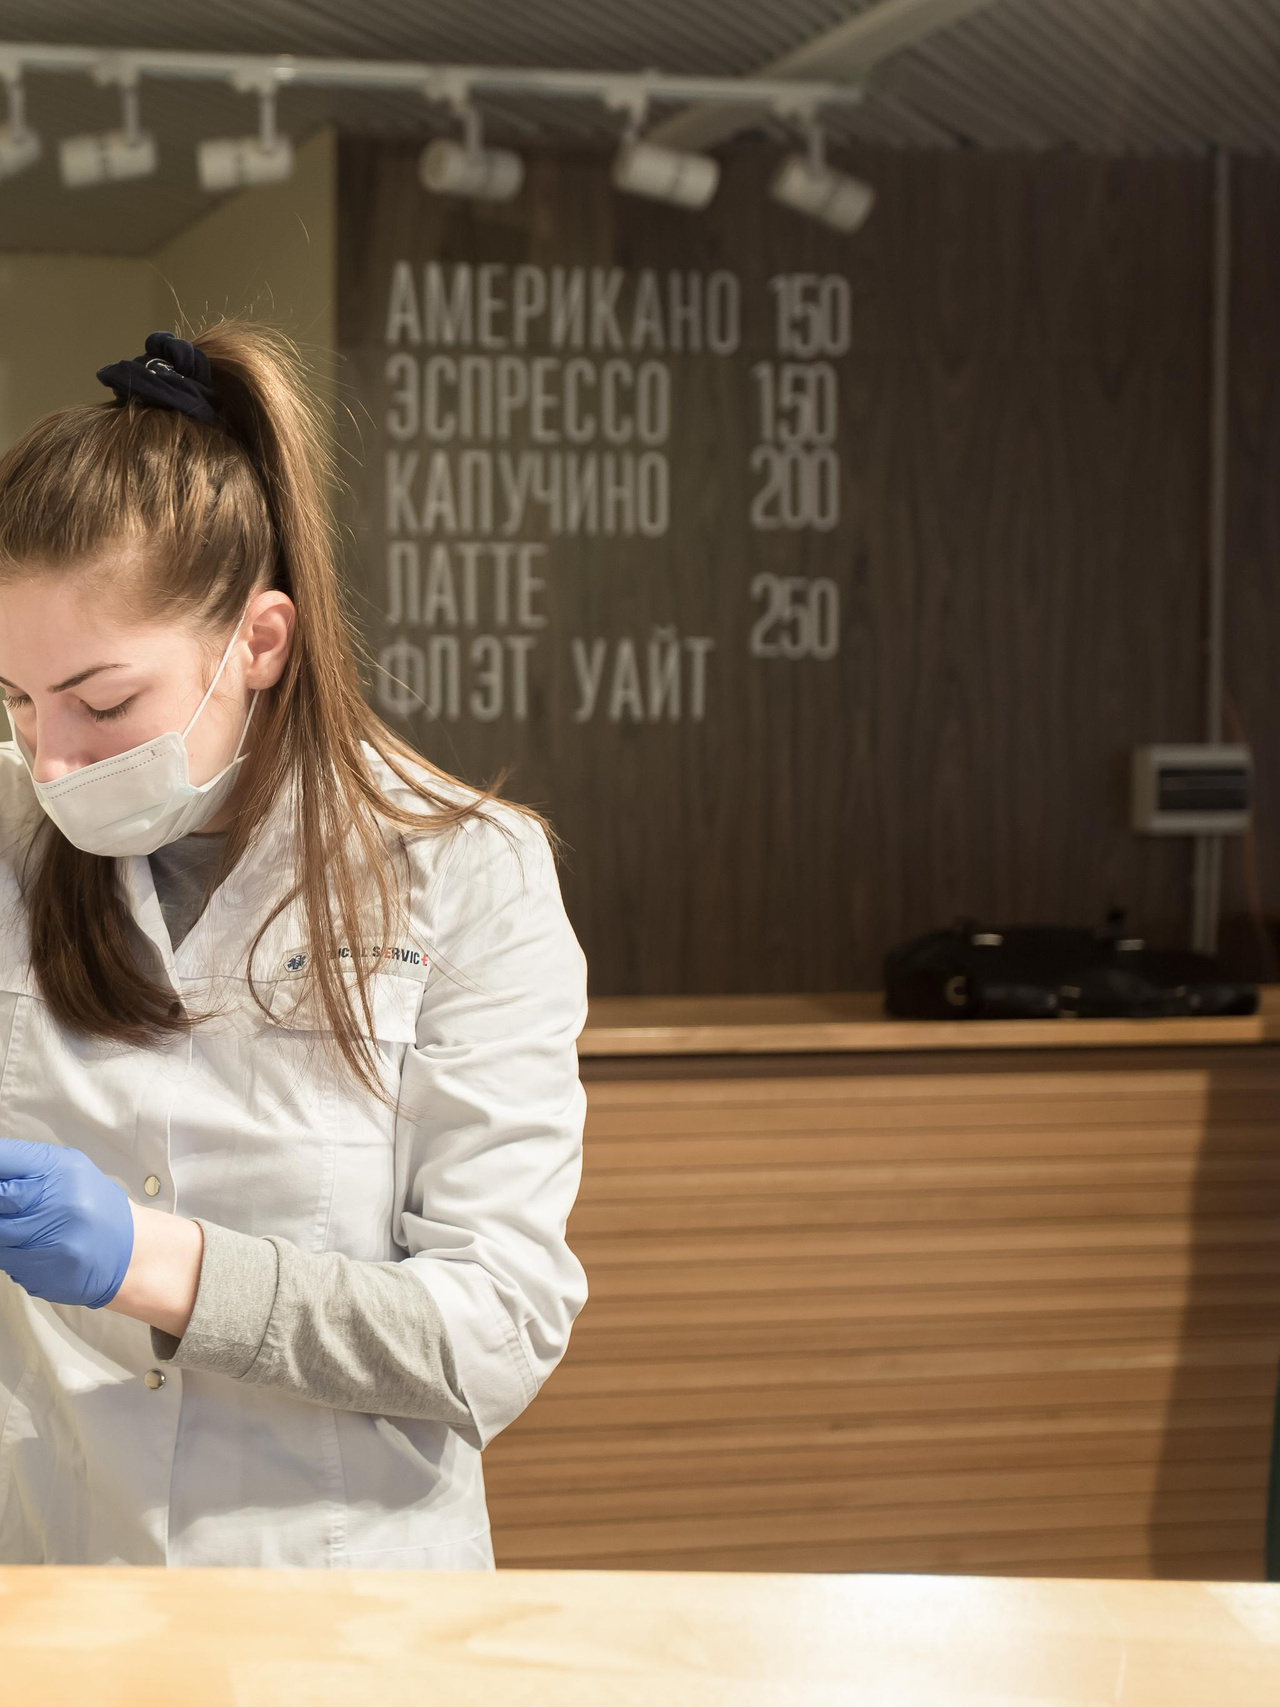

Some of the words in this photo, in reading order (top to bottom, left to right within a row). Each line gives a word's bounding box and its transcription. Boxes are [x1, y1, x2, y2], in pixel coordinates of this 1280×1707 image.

[385, 261, 741, 356] АМЕРИКАНО
[768, 273, 851, 357] 150
[386, 354, 671, 443] ЭСПРЕССО
[751, 361, 839, 446] 150
[386, 450, 670, 536] КАПУЧИНО
[751, 445, 840, 533] 200
[387, 542, 547, 629] ЛАТТЕ
[751, 572, 839, 660] 250
[376, 634, 536, 723] ФЛЭТ
[571, 625, 713, 723] УАЙТ
